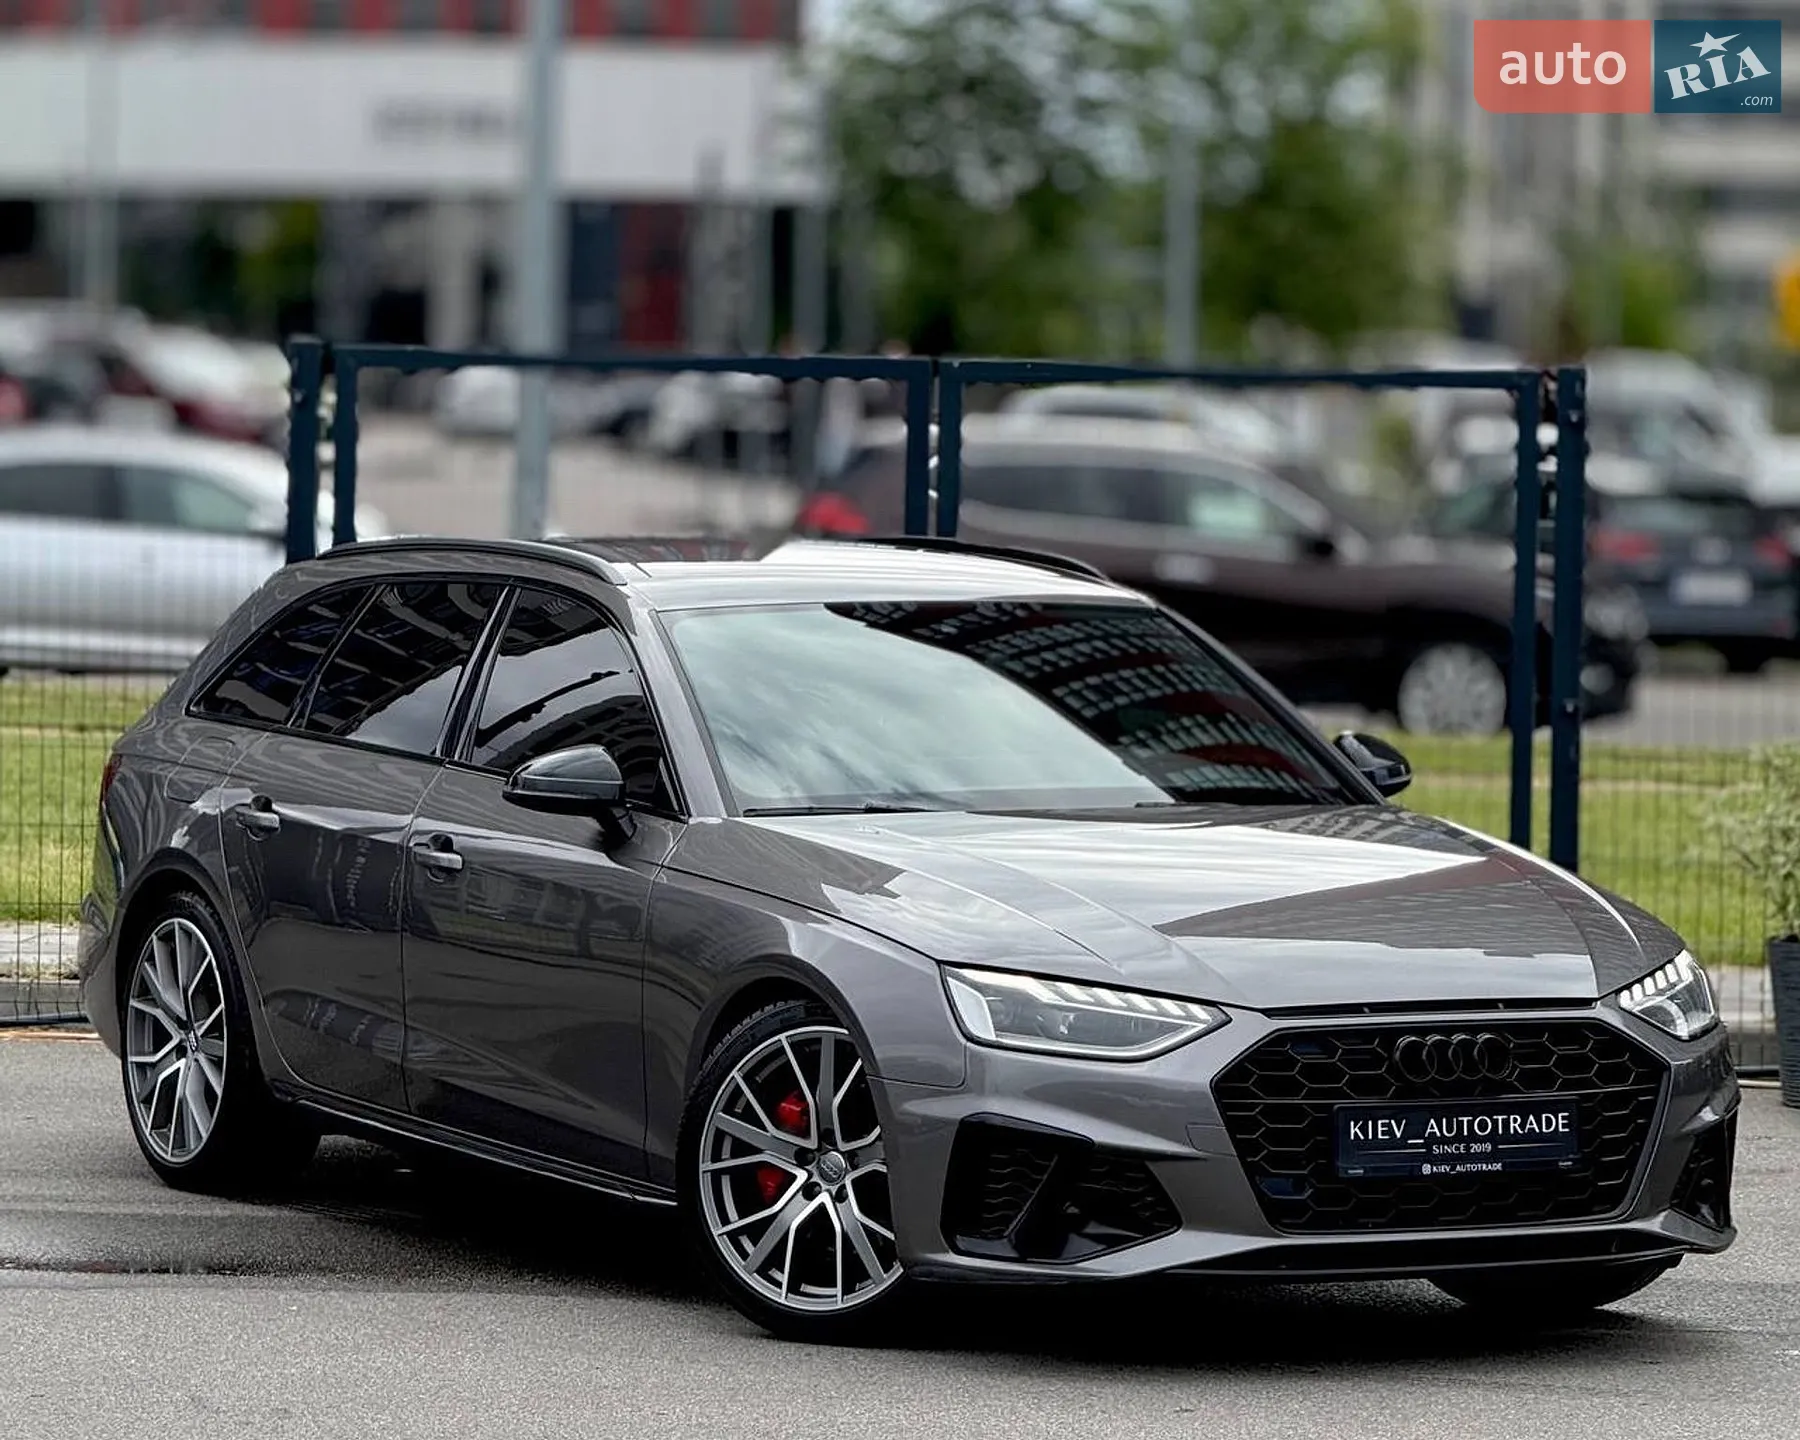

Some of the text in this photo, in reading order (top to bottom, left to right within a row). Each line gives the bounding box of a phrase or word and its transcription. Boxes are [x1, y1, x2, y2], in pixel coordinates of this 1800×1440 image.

[1350, 1112, 1571, 1144] KIEV_AUTOTRADE
[1432, 1142, 1492, 1155] SINCE 2019
[1432, 1162, 1503, 1175] KIEV_AUTOTRADE
